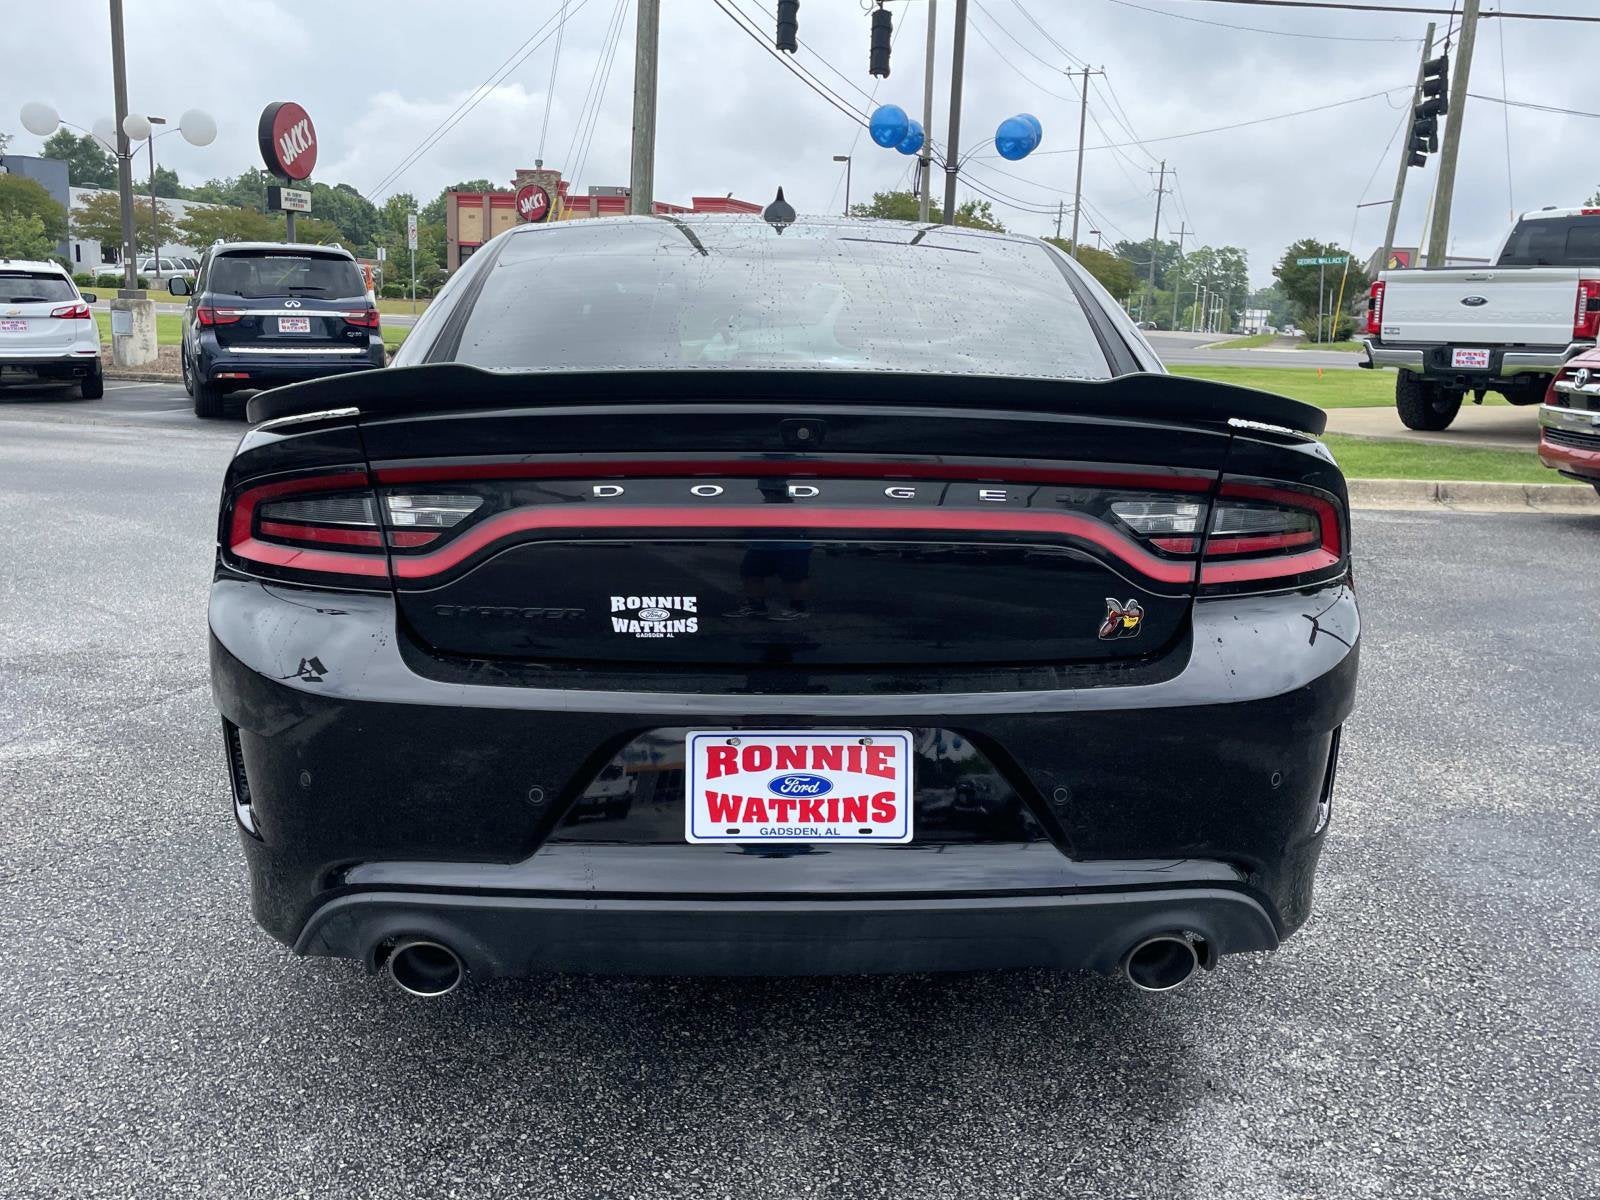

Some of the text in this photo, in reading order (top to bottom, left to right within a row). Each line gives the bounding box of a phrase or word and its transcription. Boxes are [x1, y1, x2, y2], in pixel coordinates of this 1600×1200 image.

[279, 118, 312, 166] JACK'S
[1296, 257, 1317, 266] GEORGE
[1318, 256, 1342, 265] WALLACE
[610, 596, 698, 613] RONNIE
[611, 616, 698, 633] WATKINS
[706, 745, 896, 780] RONNIE
[780, 776, 820, 794] Ford
[705, 790, 897, 823] WATKINS
[759, 827, 841, 837] GADSDEN, AL
